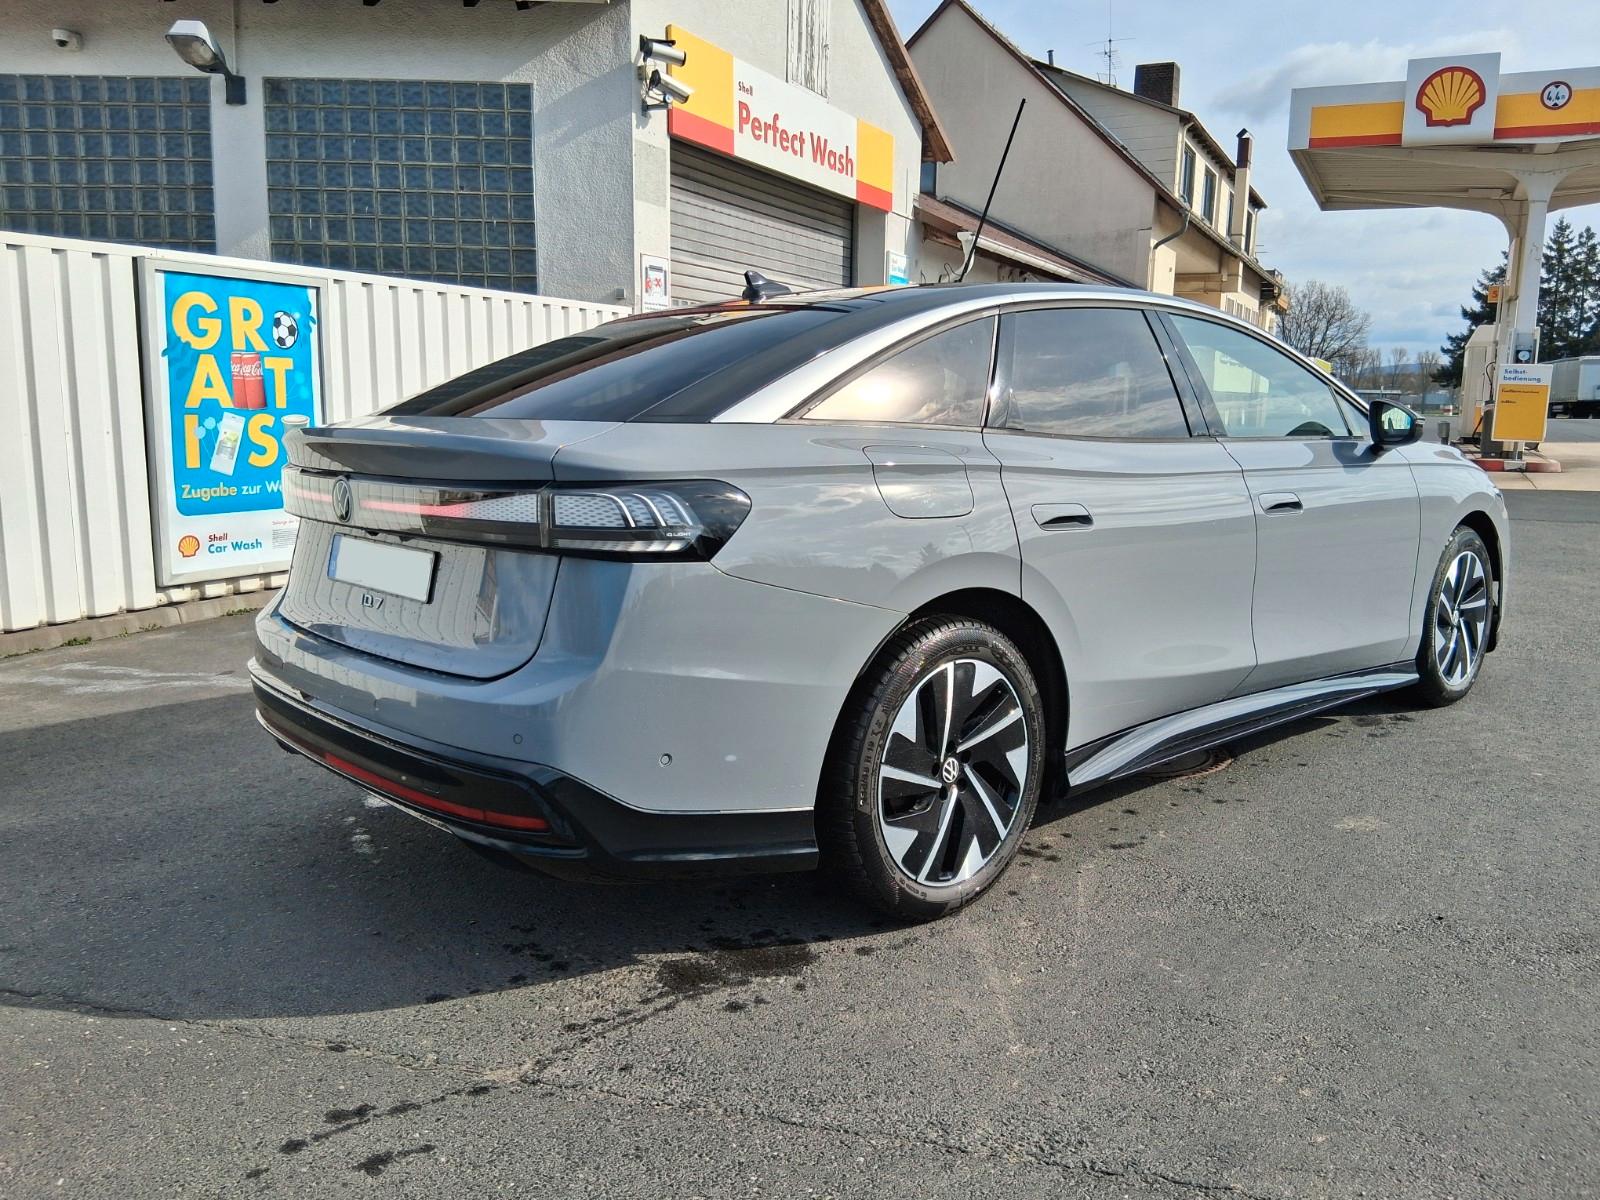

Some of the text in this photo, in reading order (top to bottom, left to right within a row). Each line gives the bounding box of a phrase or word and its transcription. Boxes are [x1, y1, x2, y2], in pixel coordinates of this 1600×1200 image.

[738, 80, 753, 96] Shell
[738, 100, 854, 178] Perfect Wash
[1503, 375, 1541, 383] bedienung
[182, 482, 238, 502] Zugabe
[242, 485, 262, 496] zur
[208, 533, 228, 542] Shell
[207, 543, 228, 554] Car
[231, 538, 263, 552] Wash
